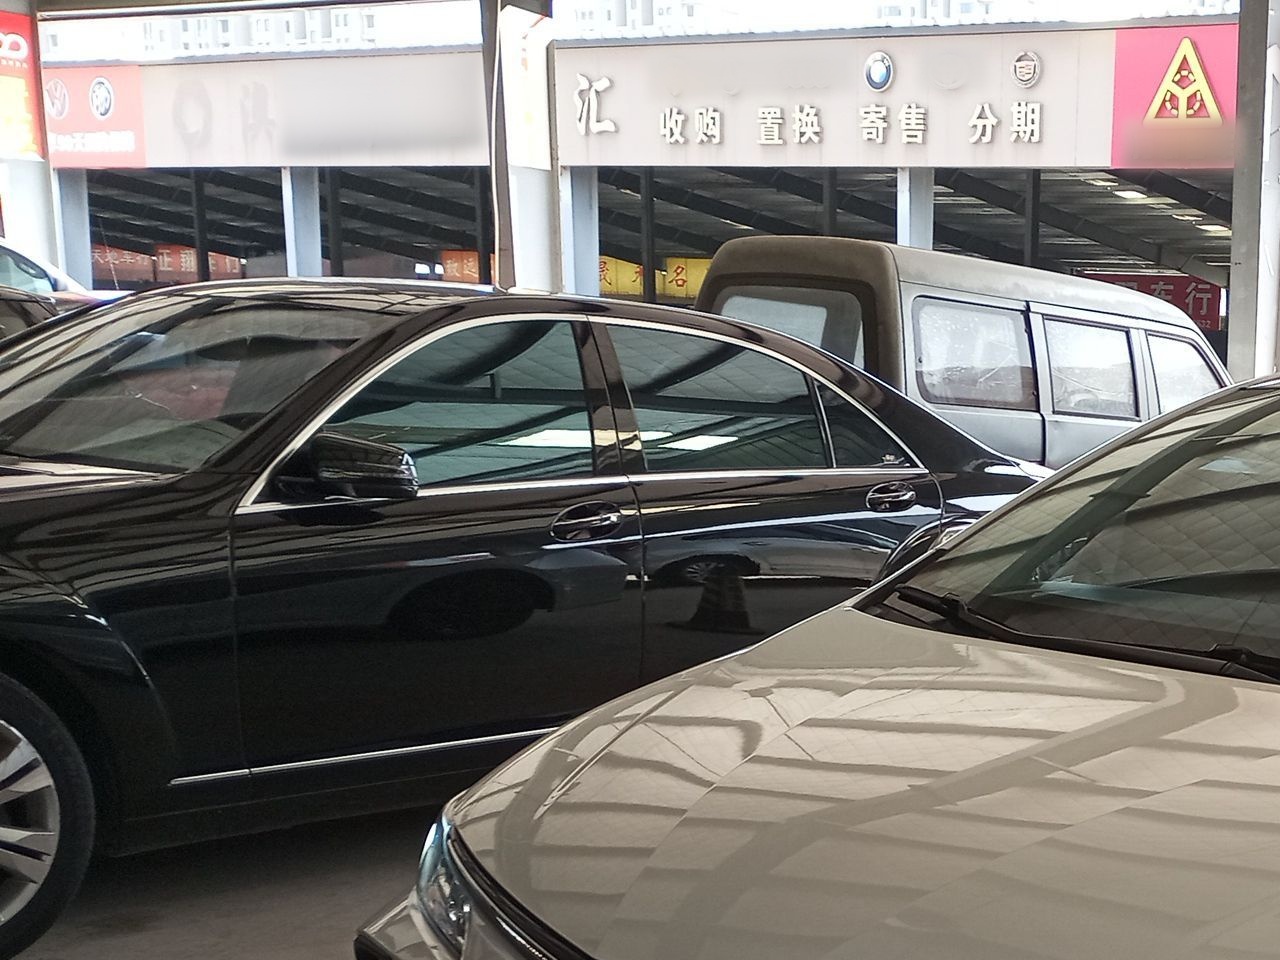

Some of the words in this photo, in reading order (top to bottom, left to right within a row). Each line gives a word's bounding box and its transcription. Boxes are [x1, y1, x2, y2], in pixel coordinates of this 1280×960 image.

[573, 73, 617, 135] 汇
[660, 106, 721, 144] 收购
[757, 104, 822, 145] 置换
[859, 102, 928, 144] 寄售
[968, 100, 1041, 144] 分期
